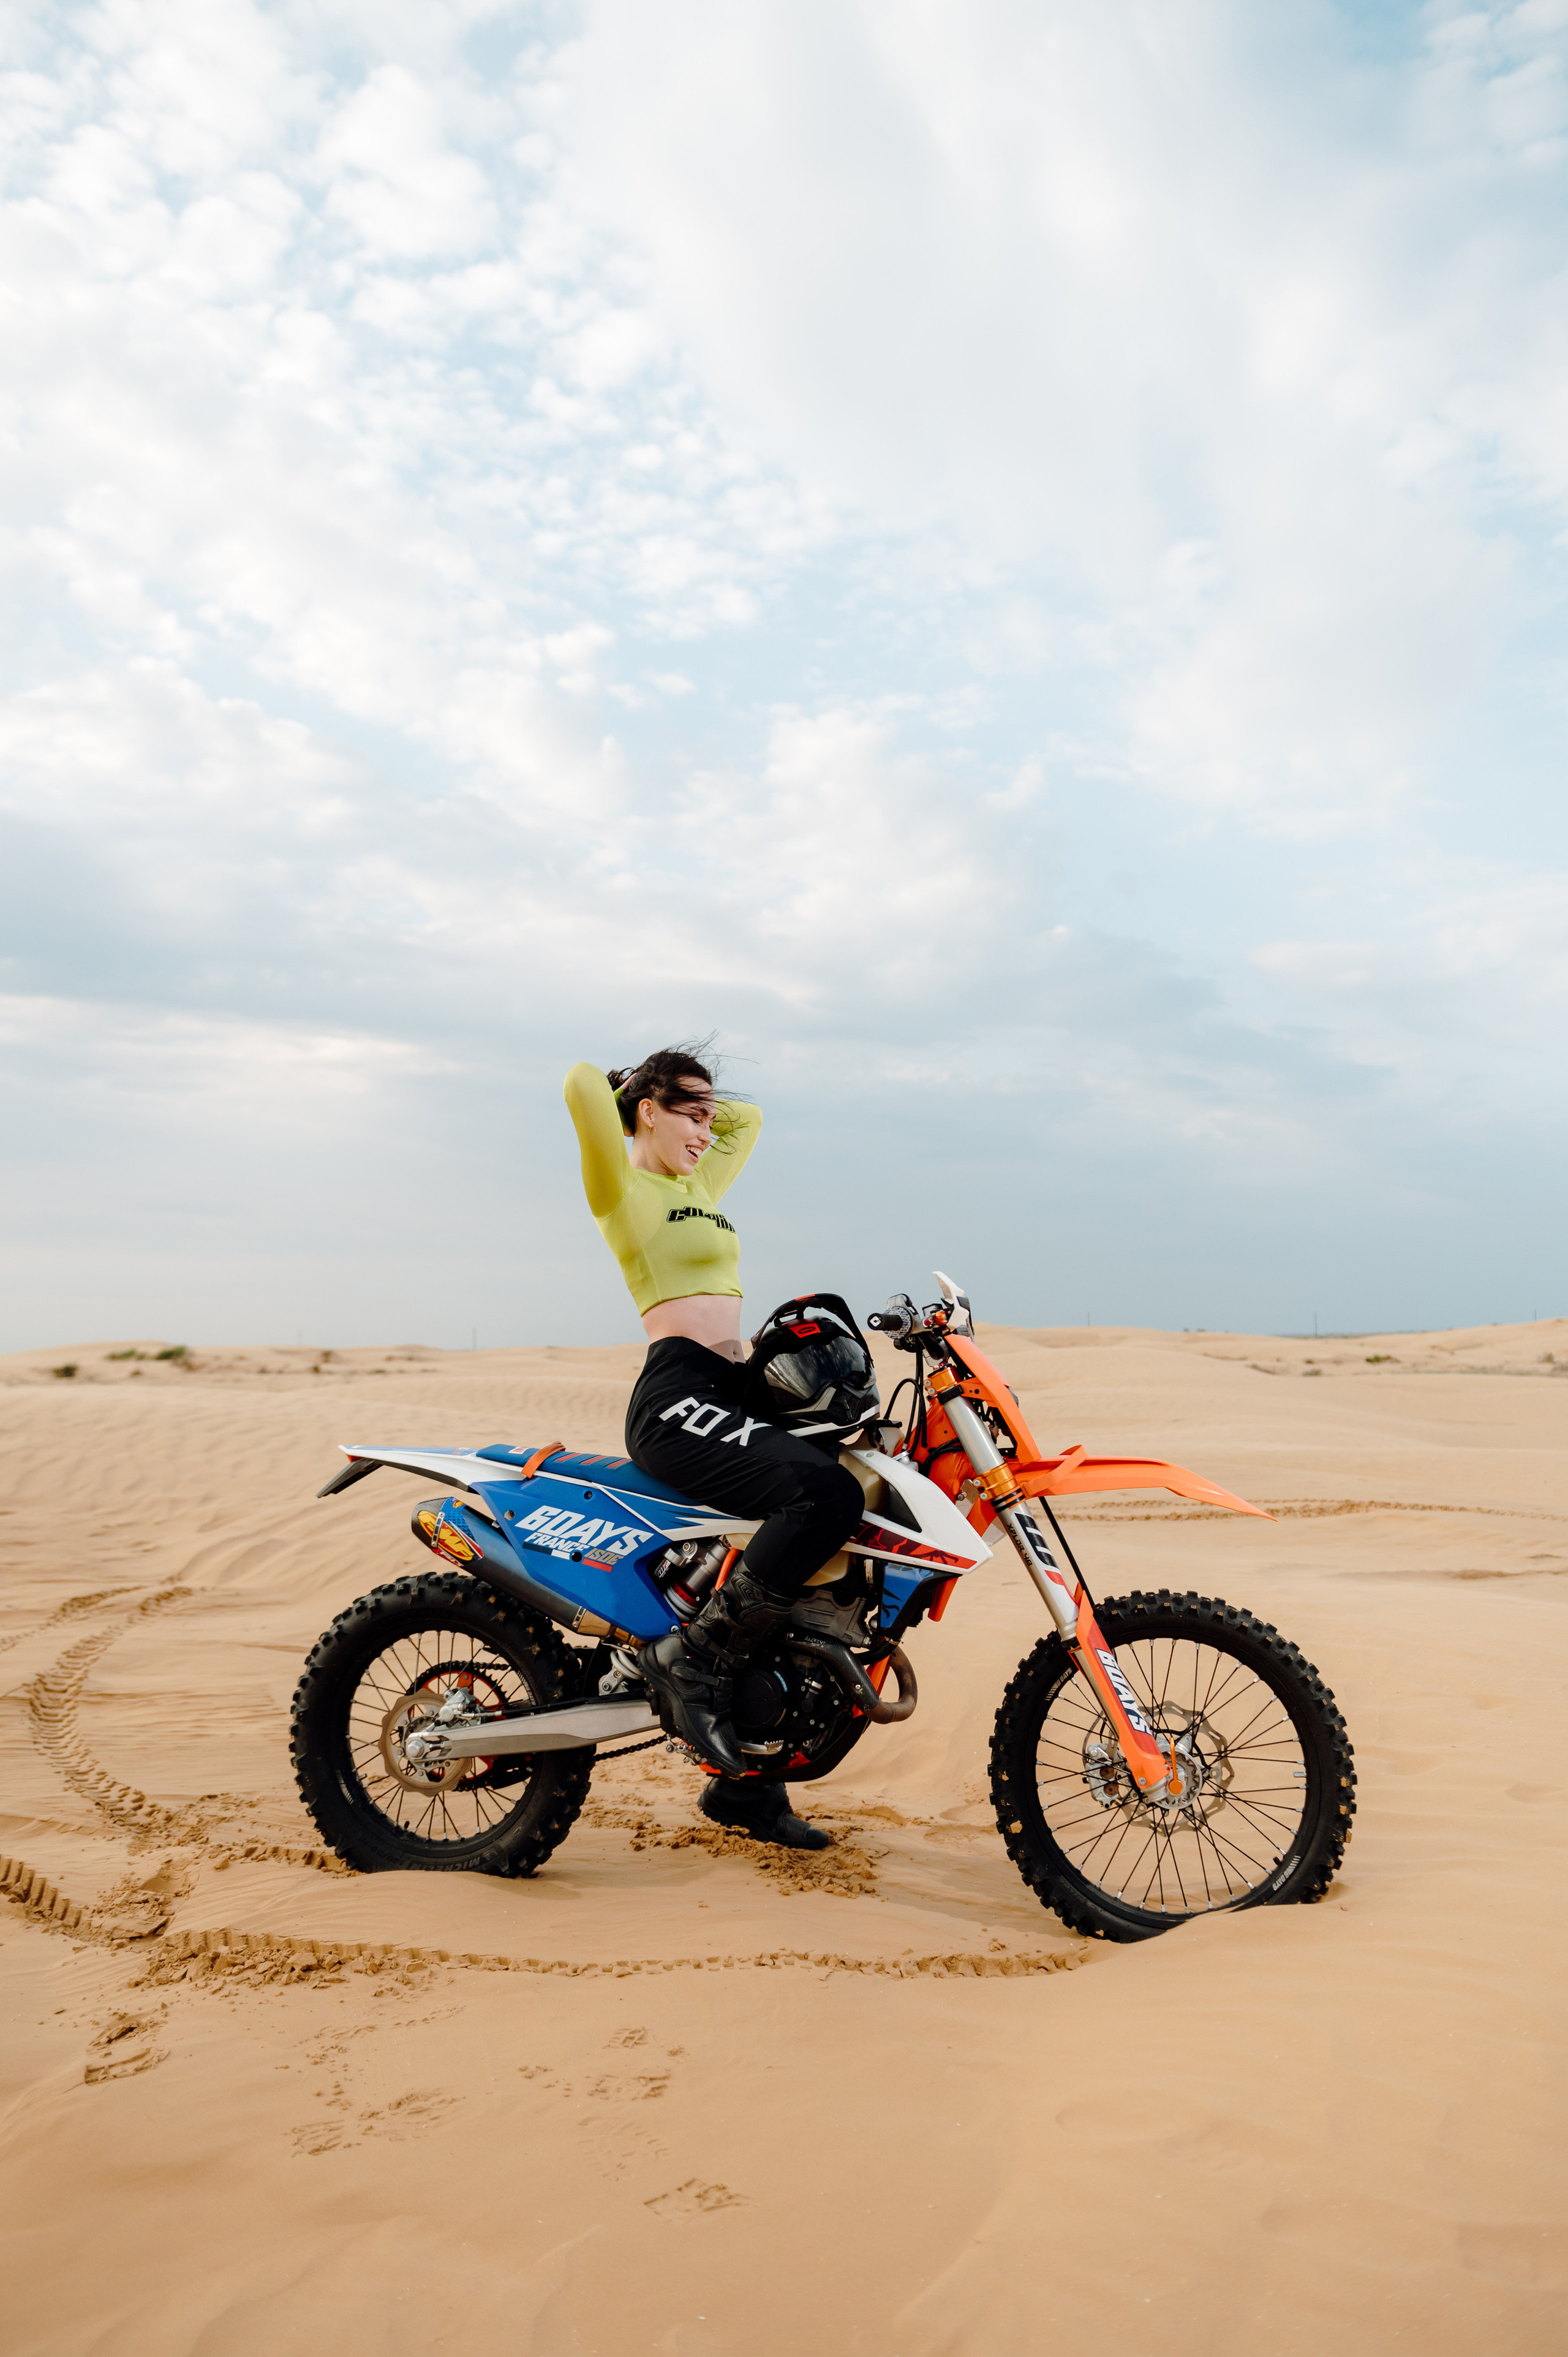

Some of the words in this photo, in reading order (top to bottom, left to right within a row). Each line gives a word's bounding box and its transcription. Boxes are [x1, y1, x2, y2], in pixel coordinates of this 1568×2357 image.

[658, 1396, 772, 1447] FOX
[417, 1512, 475, 1557] FMF
[514, 1505, 654, 1556] 6DAYS
[524, 1532, 590, 1552] FRANCE
[1006, 1523, 1025, 1553] XPLOR
[1024, 1553, 1033, 1567] 48
[1096, 1648, 1153, 1736] 6DAYS
